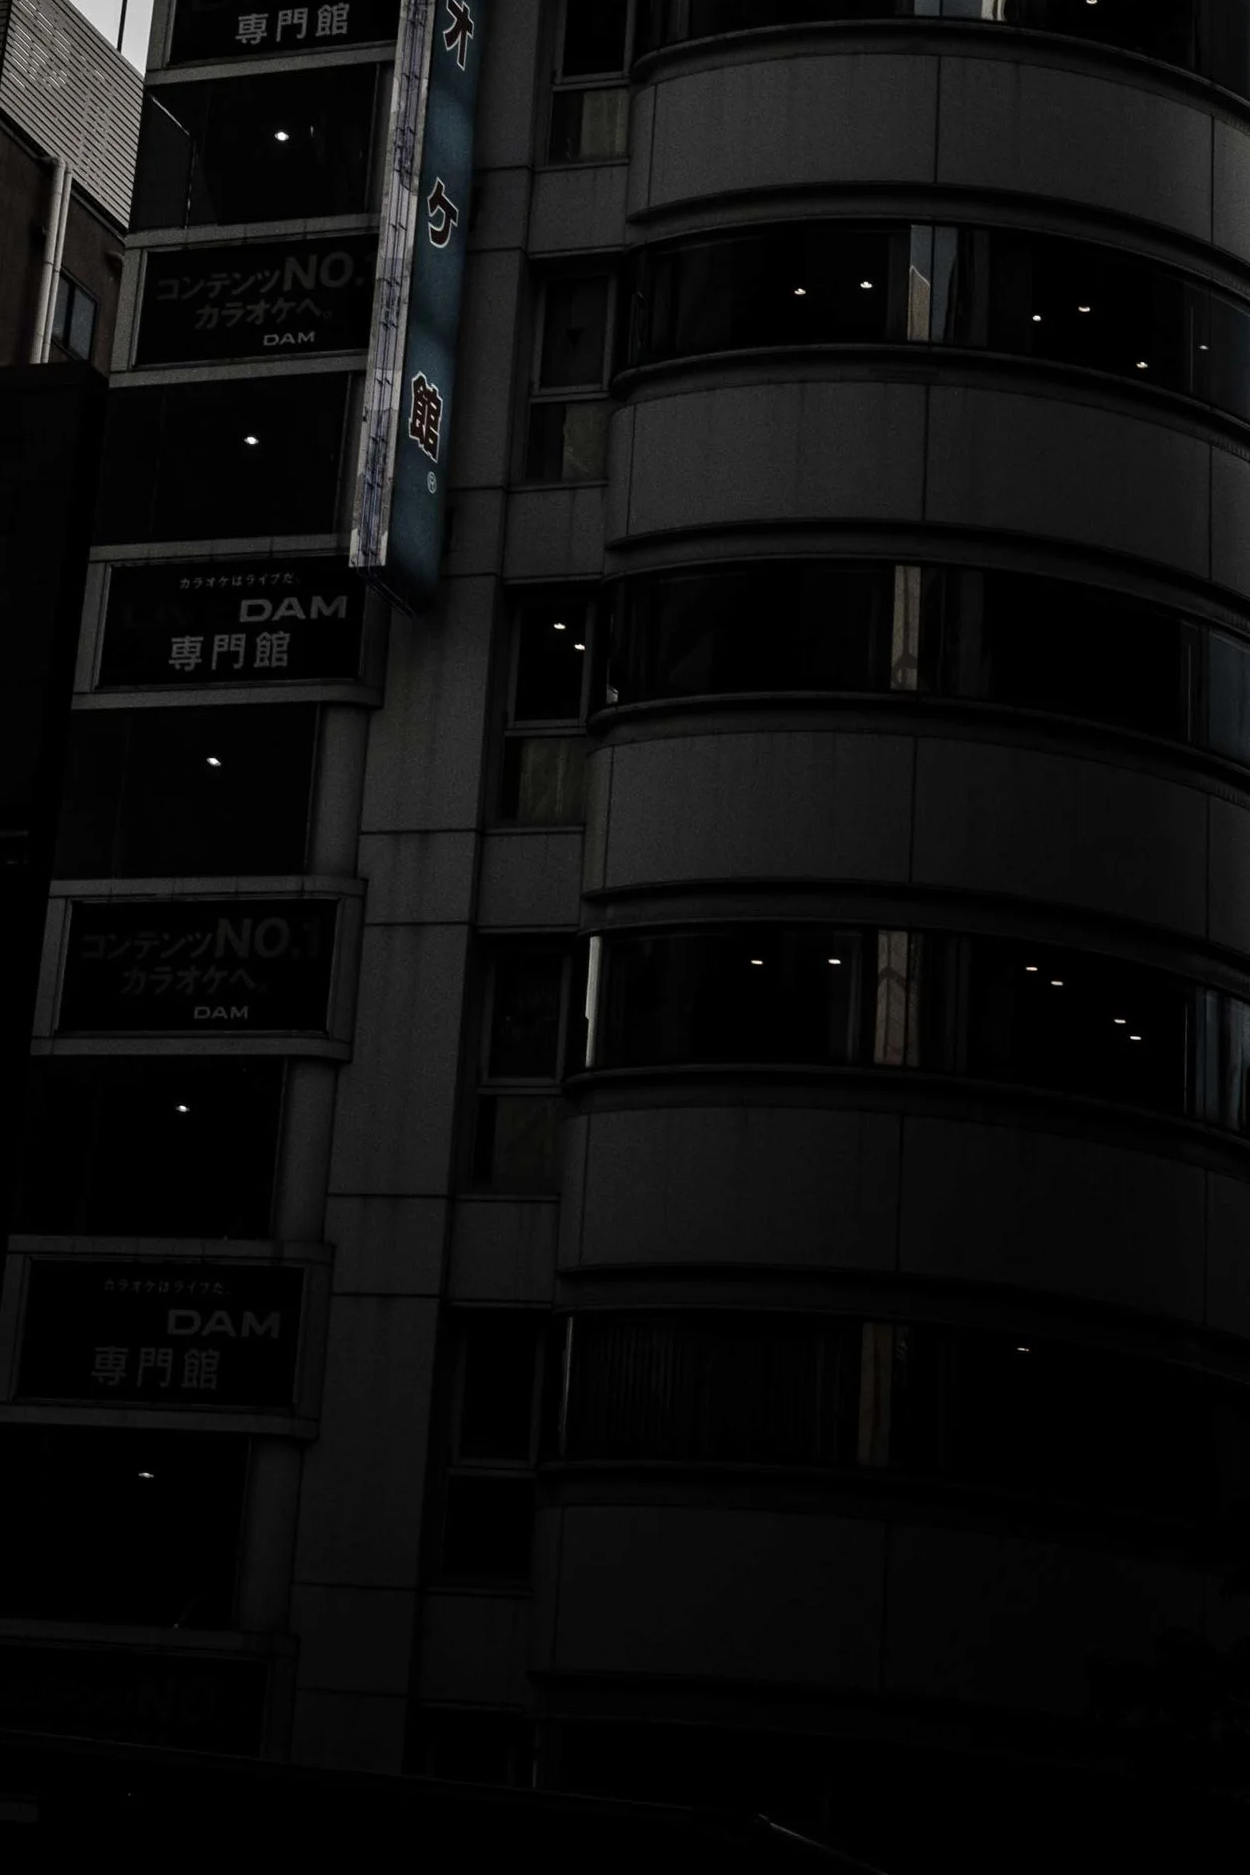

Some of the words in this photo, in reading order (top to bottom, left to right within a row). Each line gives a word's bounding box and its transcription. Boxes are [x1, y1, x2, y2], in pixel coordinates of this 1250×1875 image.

[234, 2, 351, 46] 専門館
[262, 330, 316, 348] DAM
[238, 593, 349, 623] DAM
[168, 630, 292, 672] 専門館
[193, 1004, 250, 1023] DAM
[166, 1308, 282, 1341] DAM
[90, 1345, 221, 1391] 専門館
